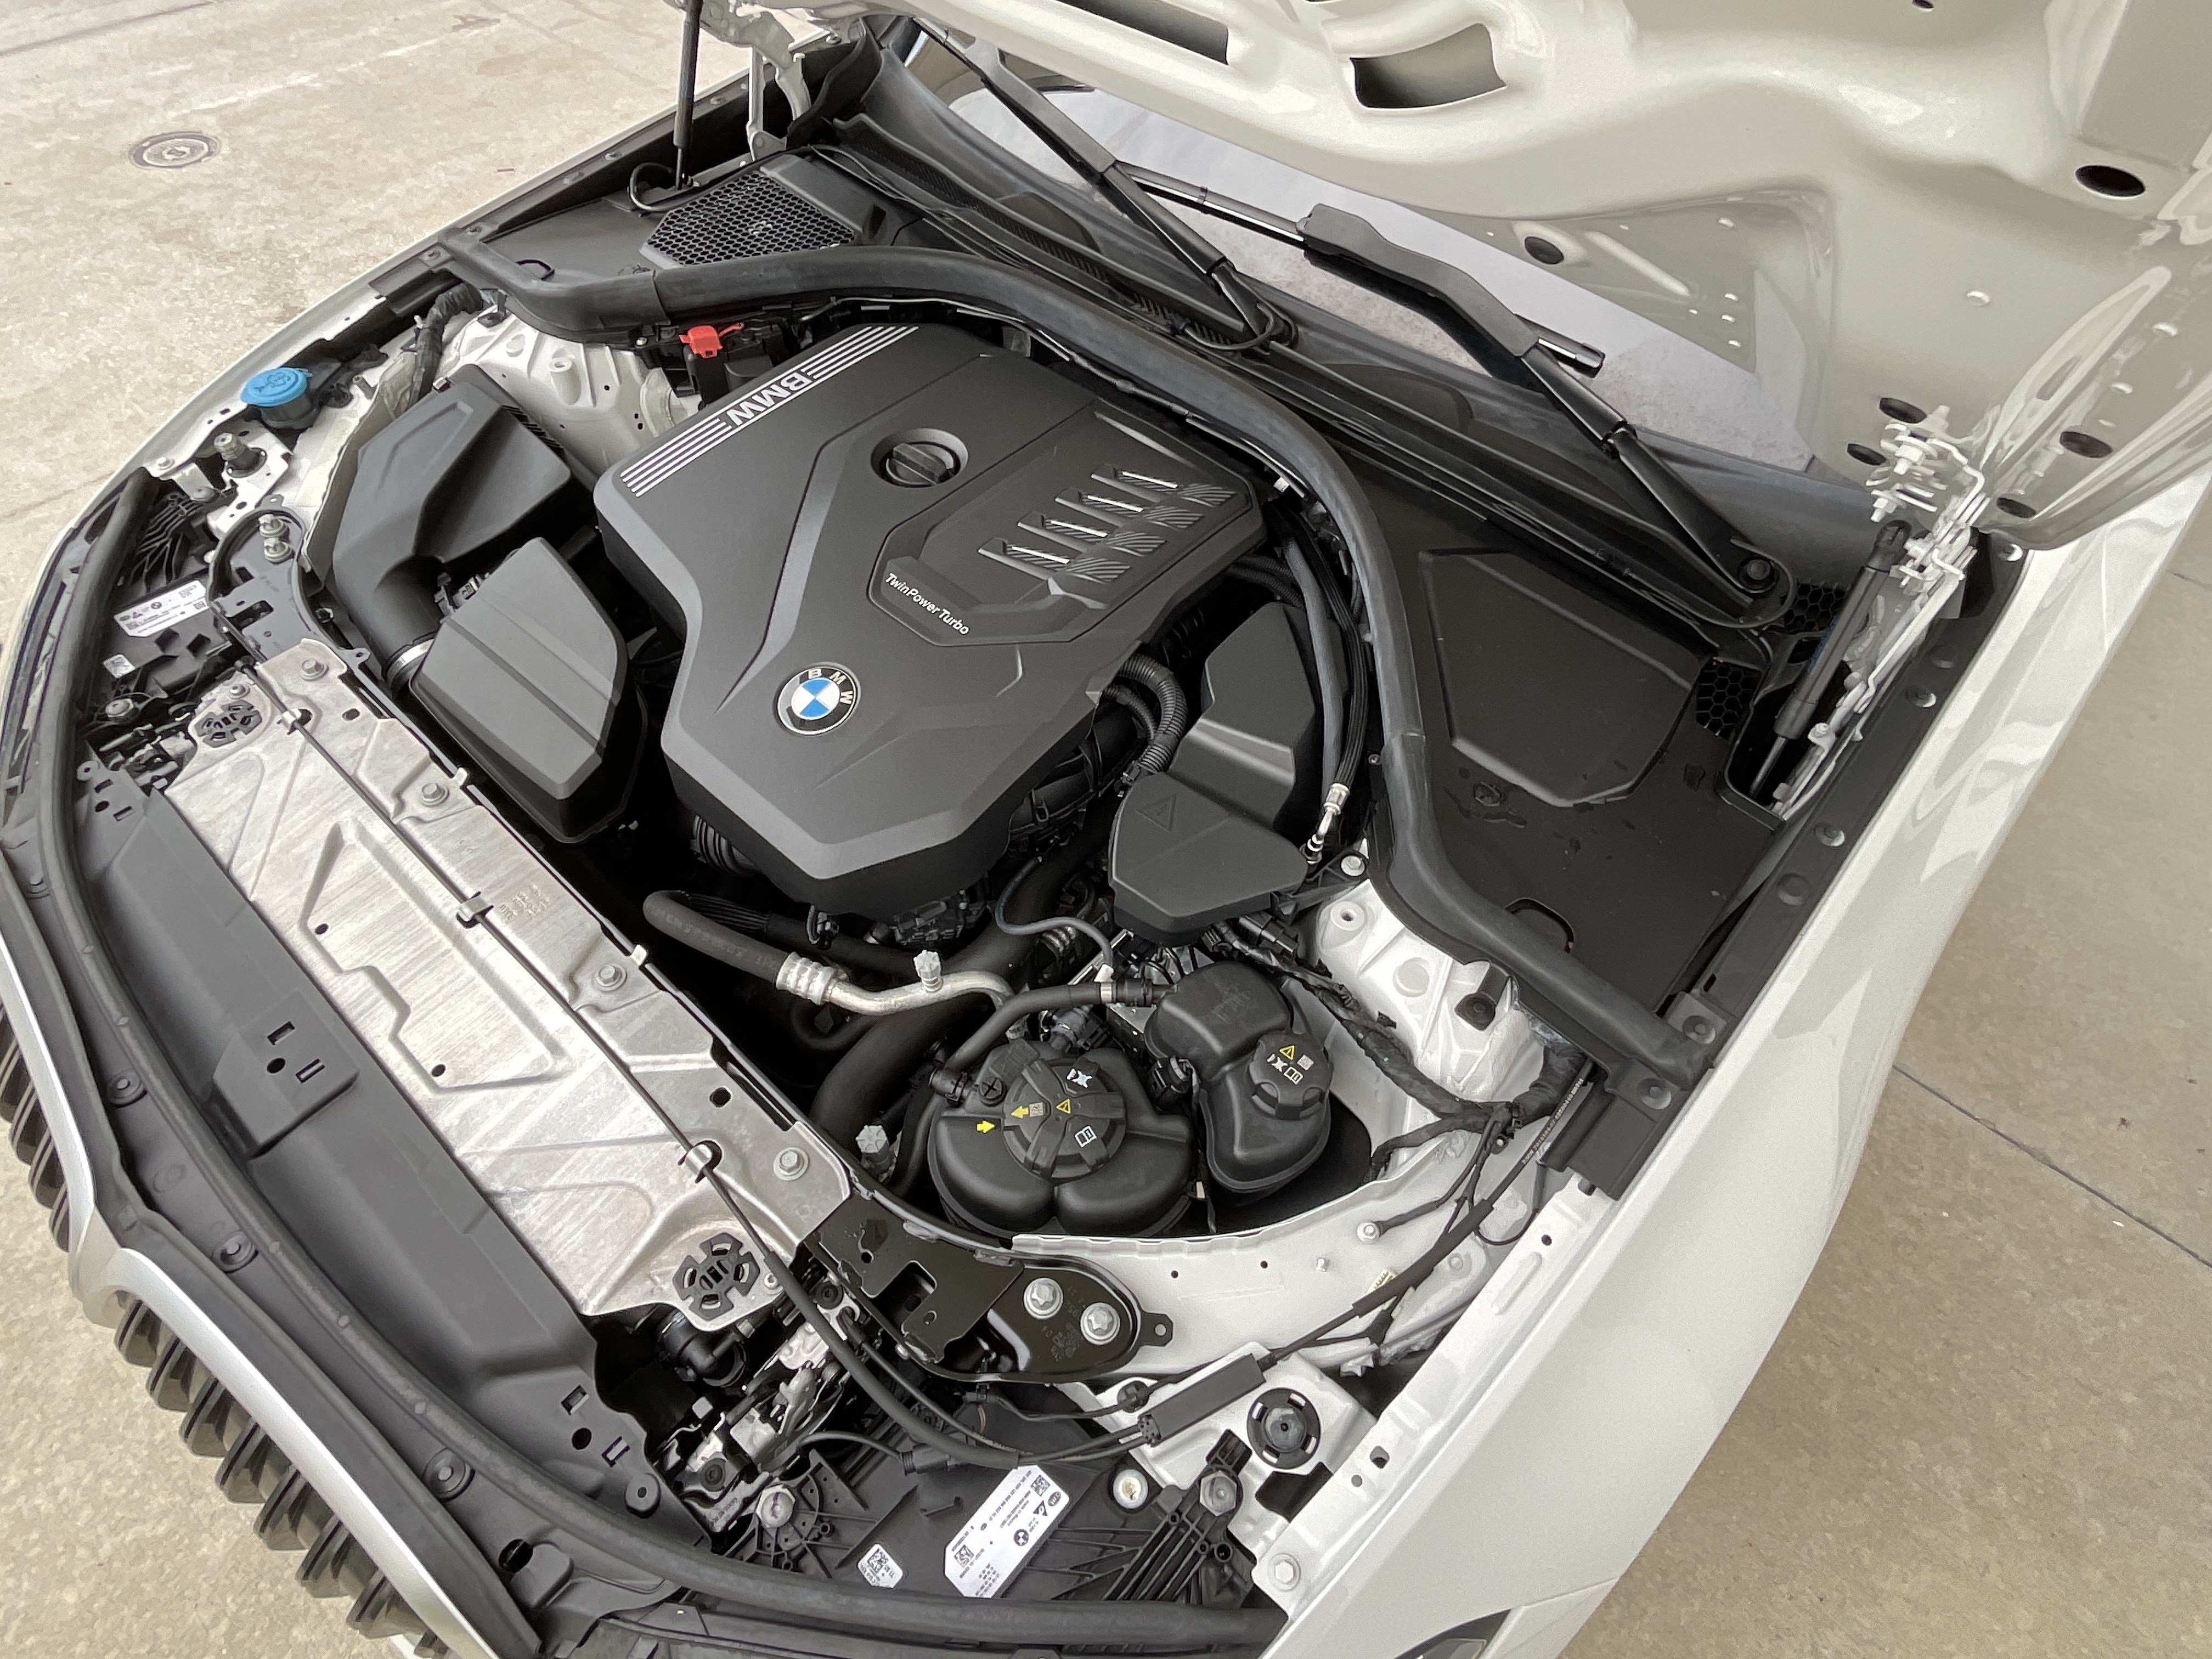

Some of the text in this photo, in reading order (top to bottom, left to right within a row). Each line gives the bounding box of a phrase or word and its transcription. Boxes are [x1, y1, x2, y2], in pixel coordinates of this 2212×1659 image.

[726, 372, 813, 426] BMW
[885, 572, 969, 635] TwinPower Turbo
[808, 668, 854, 704] BMW
